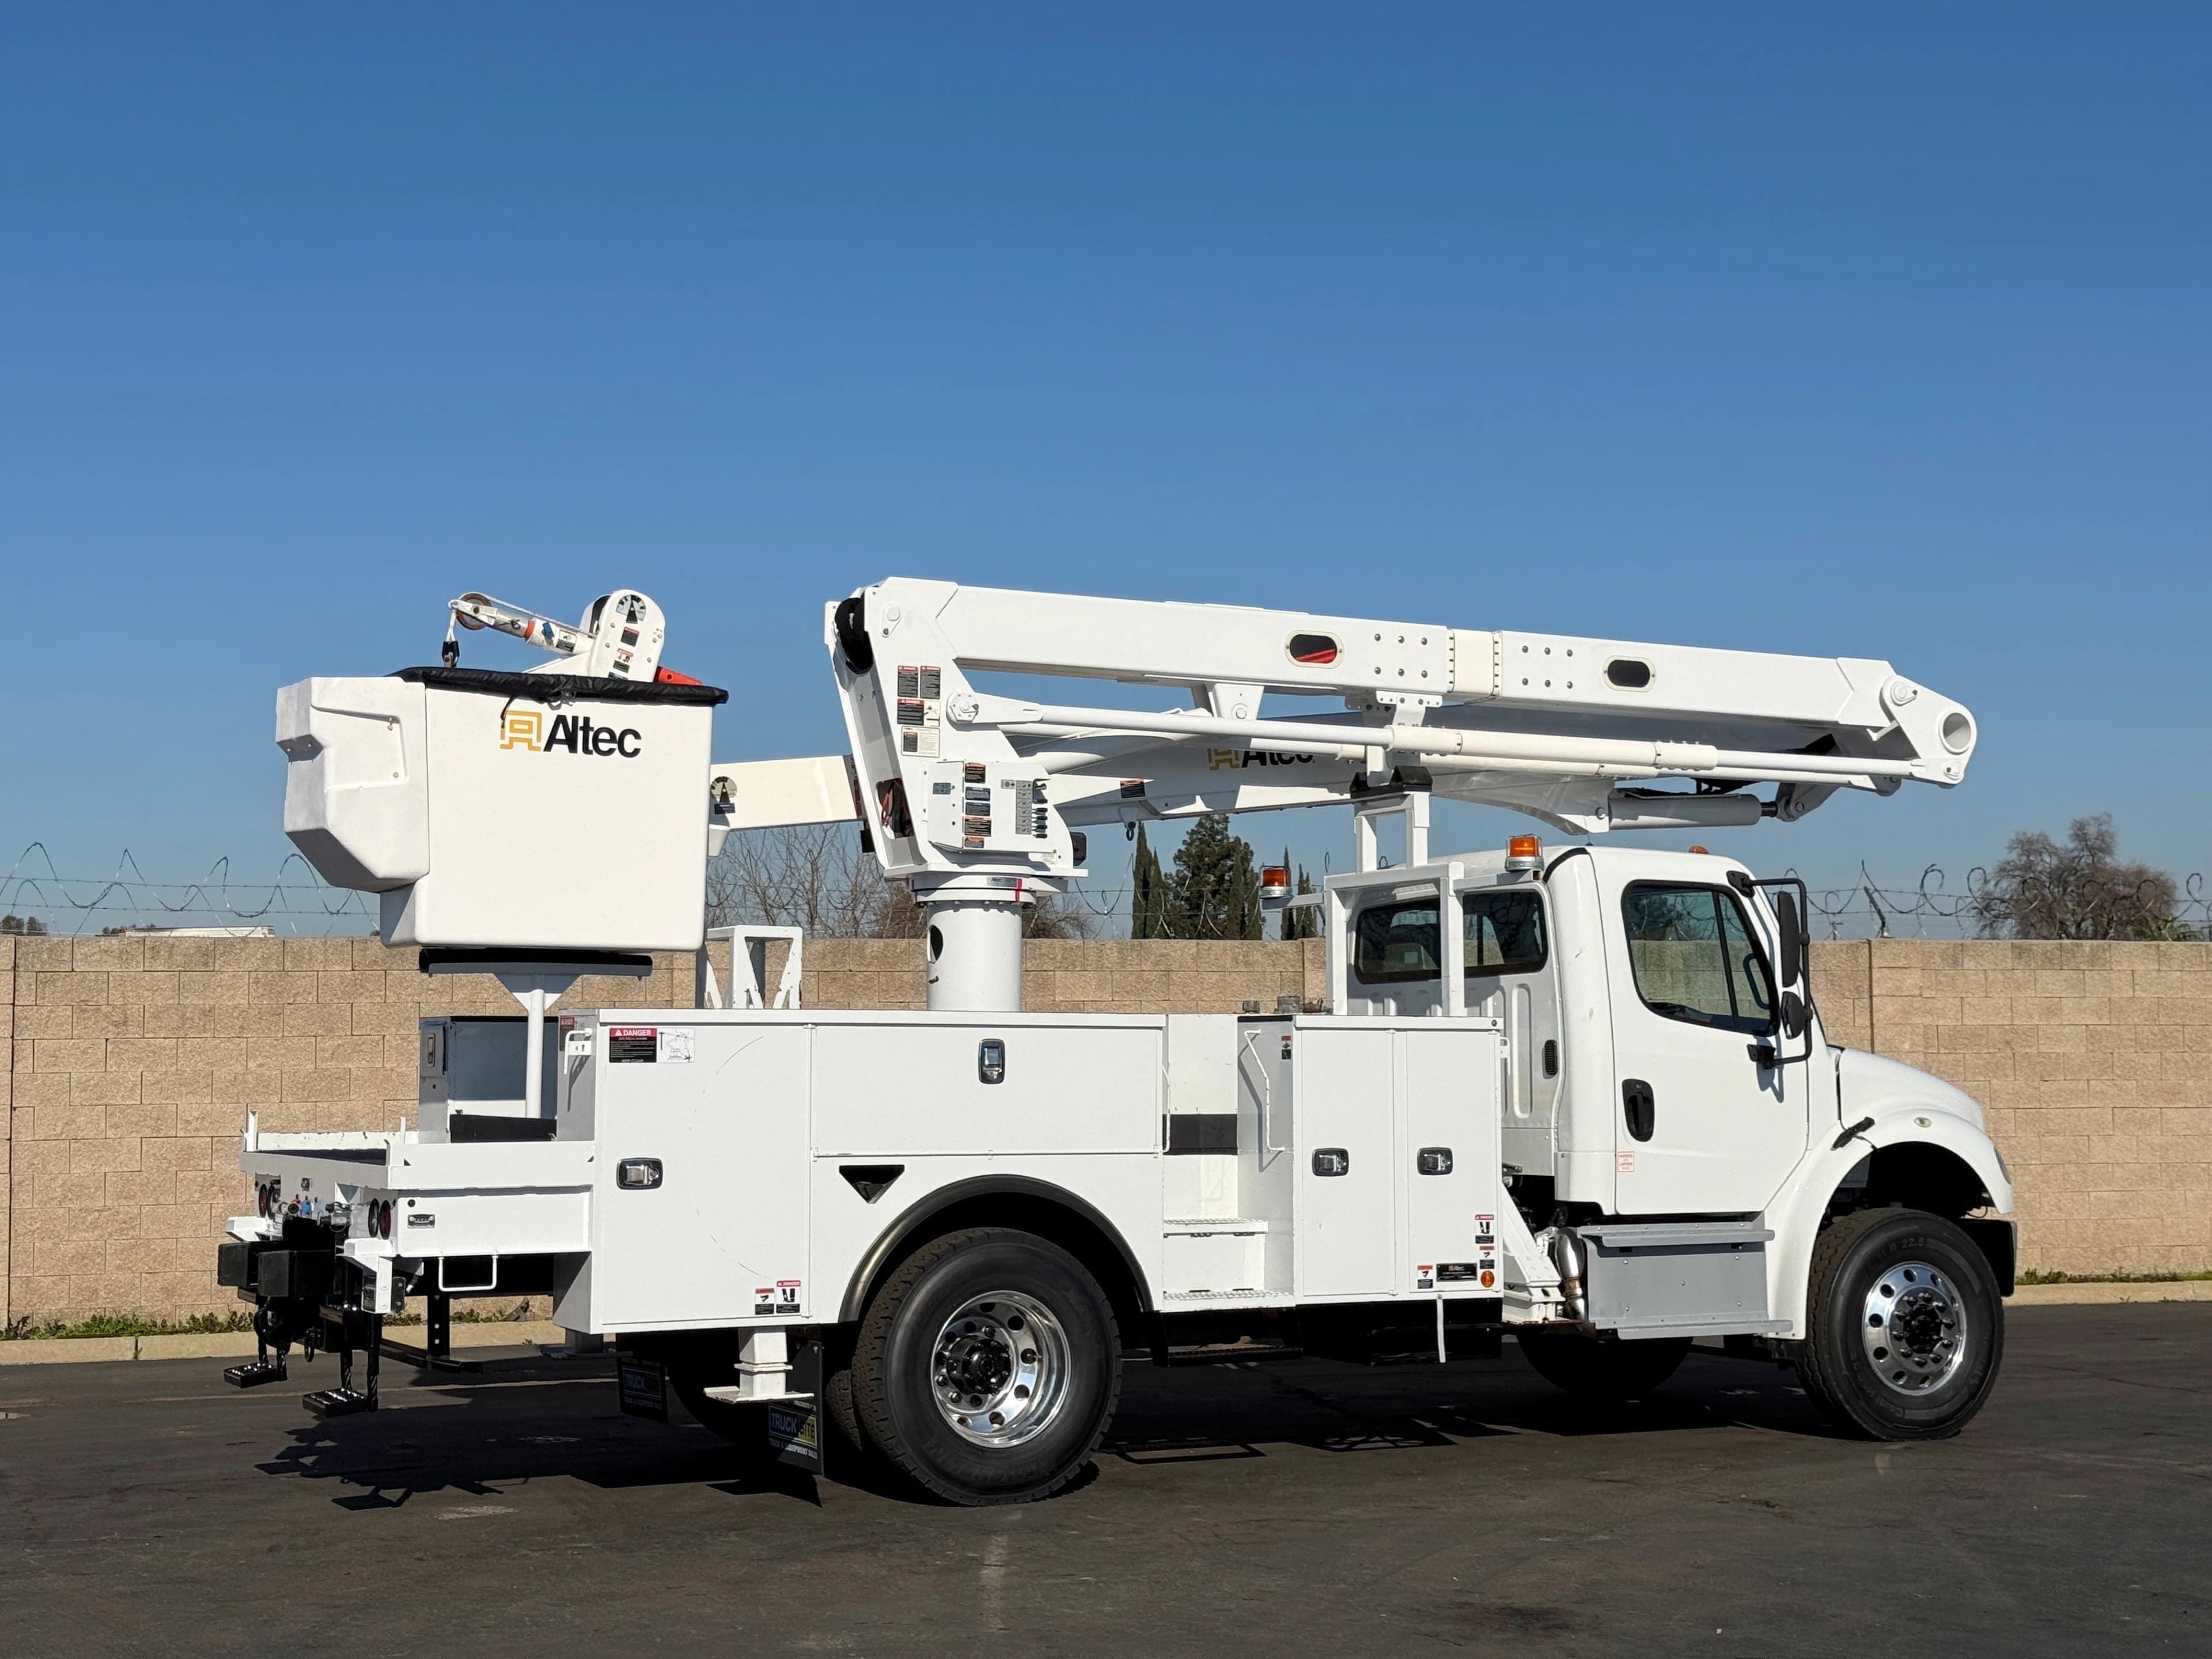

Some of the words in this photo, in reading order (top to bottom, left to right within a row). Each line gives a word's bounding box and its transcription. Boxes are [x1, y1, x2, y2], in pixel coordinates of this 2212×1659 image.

[543, 714, 642, 758] Altec
[1902, 1237, 1925, 1249] 22.5
[771, 1412, 797, 1434] TRUCK
